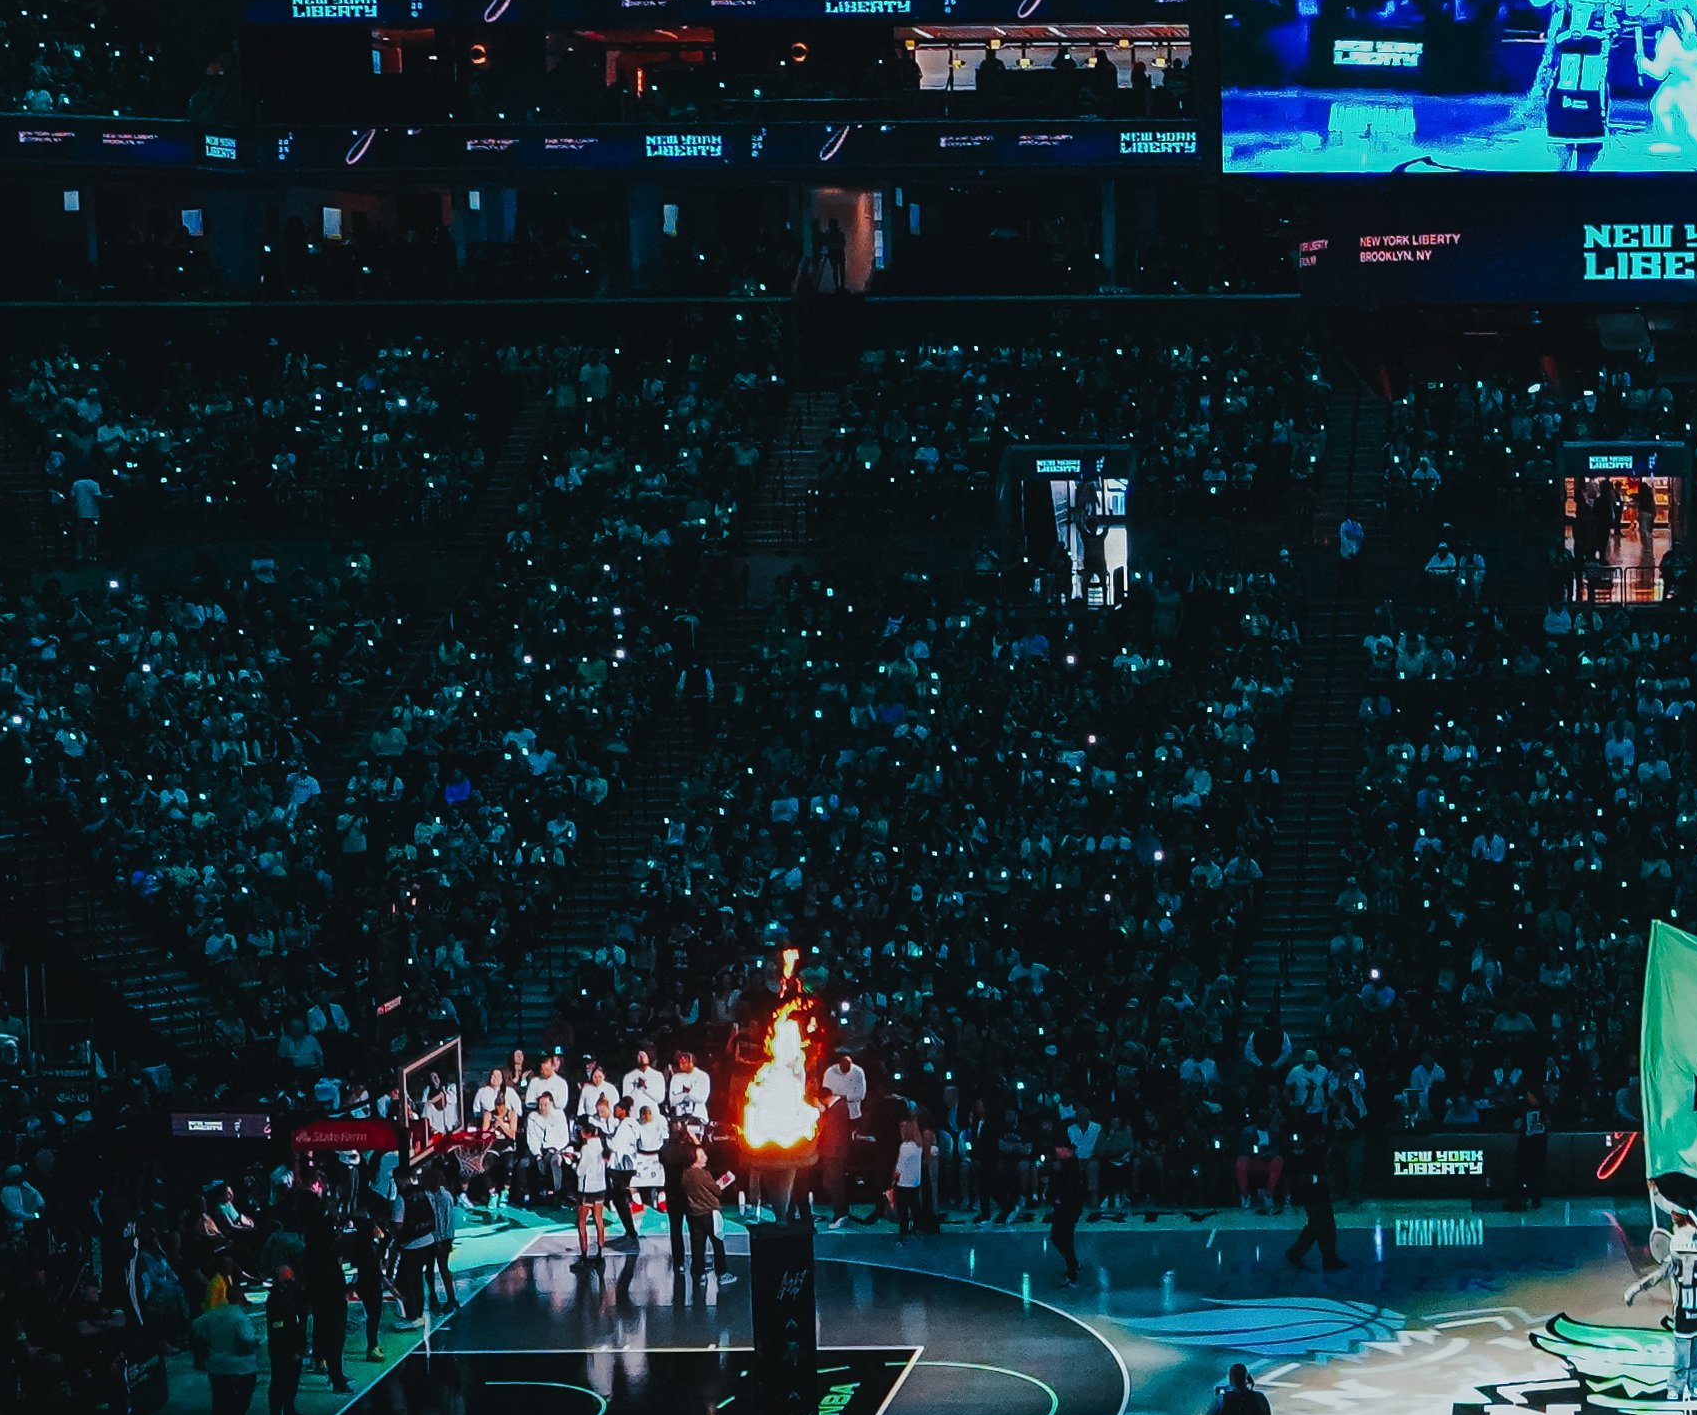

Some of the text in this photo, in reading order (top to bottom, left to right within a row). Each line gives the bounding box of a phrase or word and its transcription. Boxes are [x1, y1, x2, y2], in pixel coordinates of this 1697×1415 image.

[291, 4, 377, 17] LIBERTY
[825, 0, 911, 14] LIBERTY
[1120, 132, 1196, 142] NEW YORK
[646, 146, 722, 157] LIBERTY
[1120, 142, 1196, 154] LIBERTY
[1360, 233, 1462, 248] NEW YORK LIBERTY
[1583, 223, 1674, 248] NEW
[1417, 249, 1433, 261] NY
[1394, 1150, 1484, 1162] NEW YORK
[1394, 1162, 1483, 1176] LIBERTY
